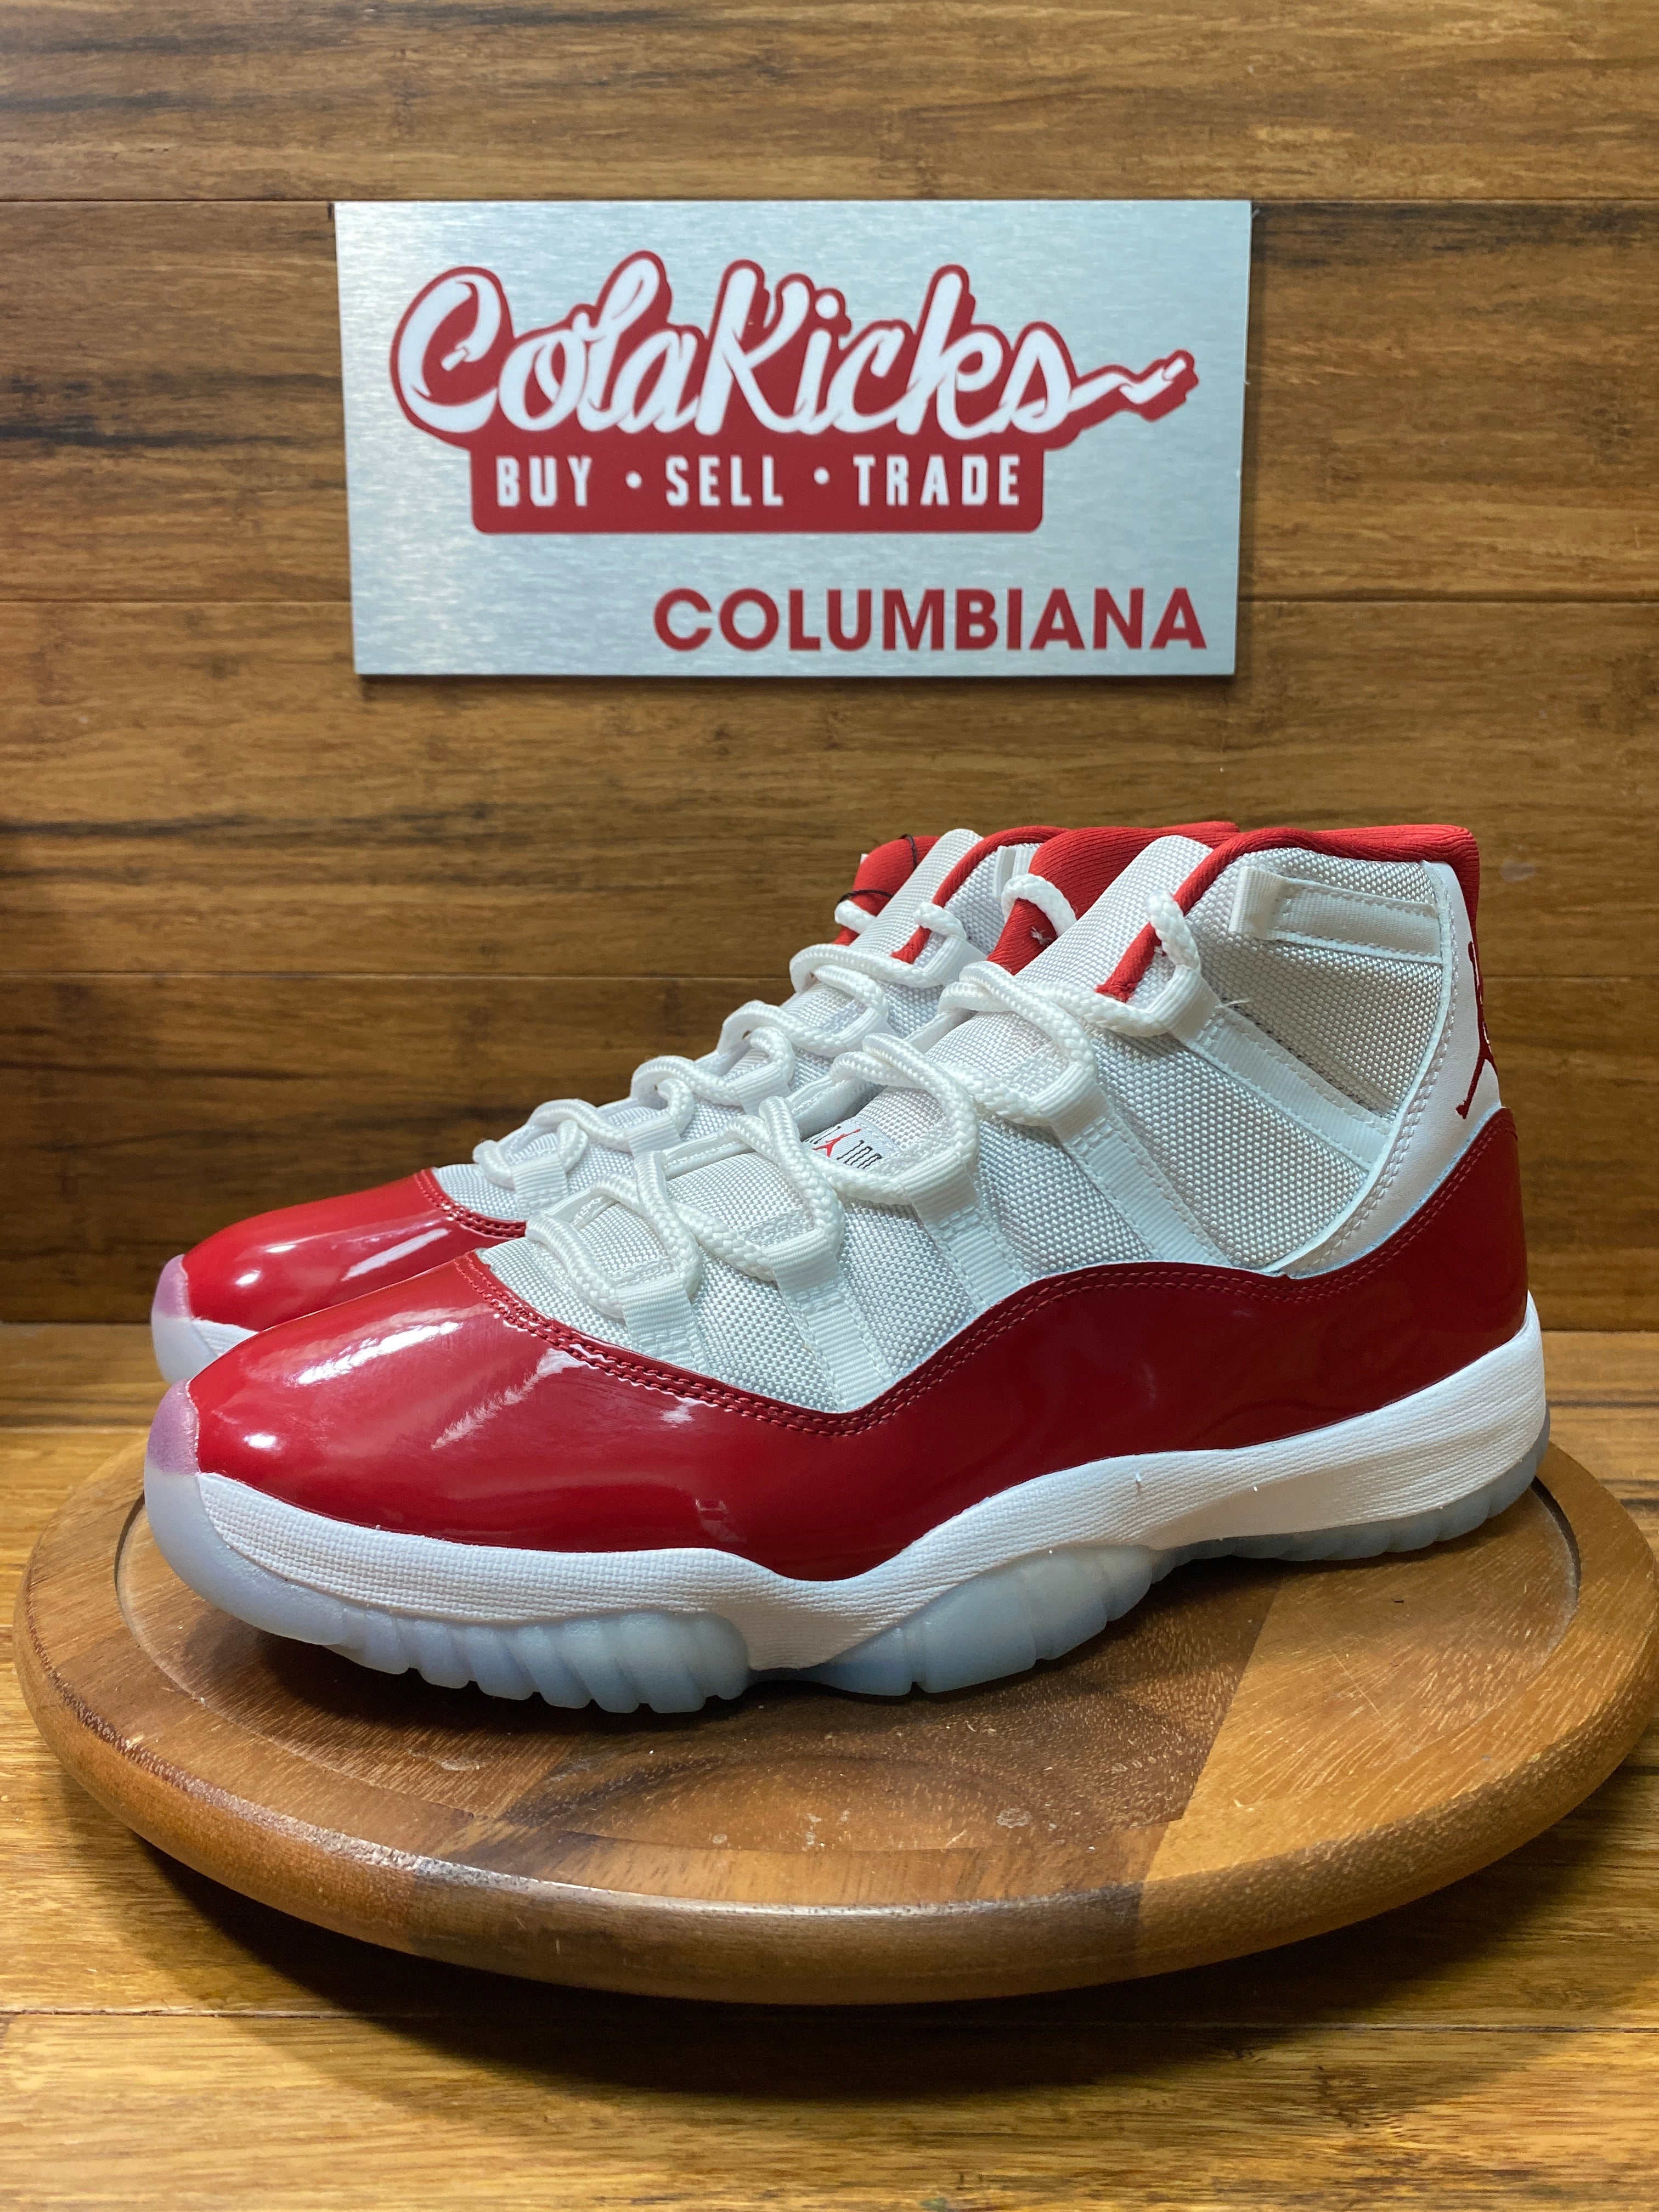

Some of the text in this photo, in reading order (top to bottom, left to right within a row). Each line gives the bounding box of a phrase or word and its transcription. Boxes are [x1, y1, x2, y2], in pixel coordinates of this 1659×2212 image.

[397, 257, 1187, 440] ColaKicks
[496, 455, 1020, 507] BUY SELL TRADE
[654, 588, 1206, 651] COLUMBIANA
